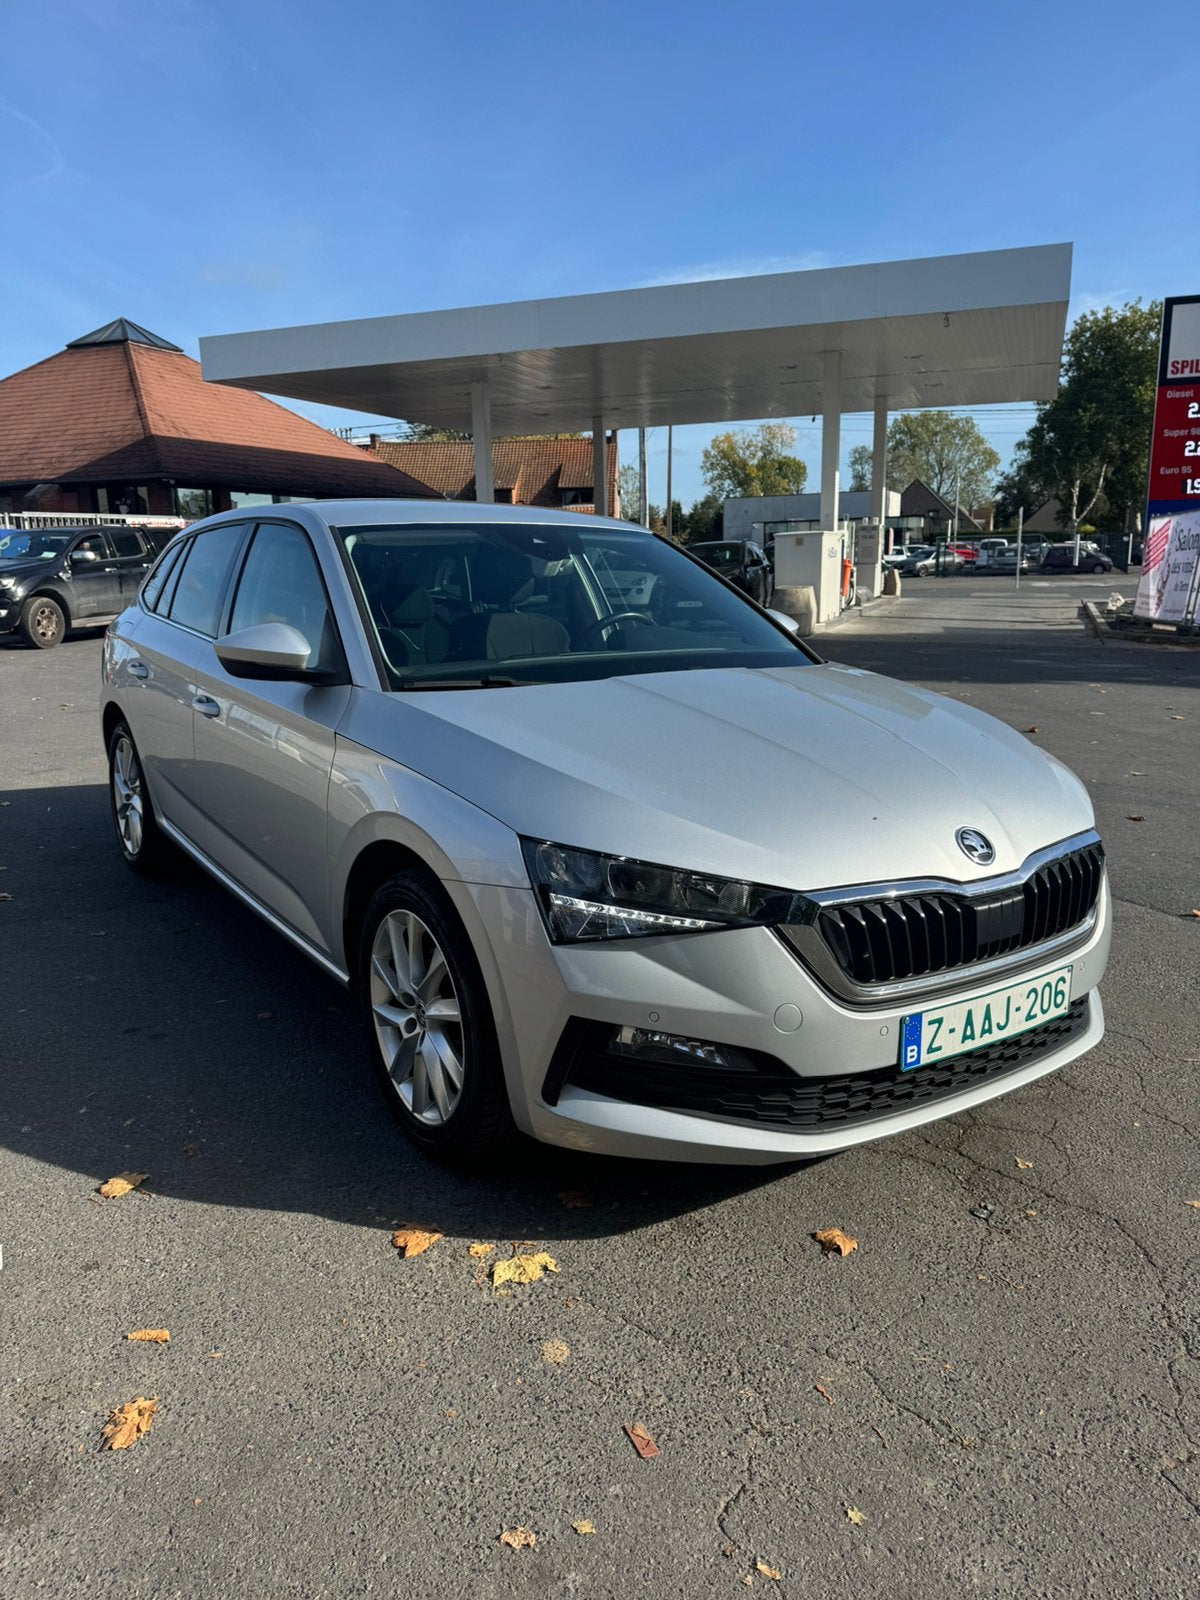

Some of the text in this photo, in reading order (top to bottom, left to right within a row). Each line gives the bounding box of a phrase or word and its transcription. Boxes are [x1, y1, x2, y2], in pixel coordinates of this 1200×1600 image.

[1166, 389, 1194, 399] Diesel
[1163, 428, 1189, 438] Super
[1160, 465, 1192, 475] Euro 95
[927, 976, 1067, 1055] Z-AAJ-206
[906, 1045, 918, 1064] B
